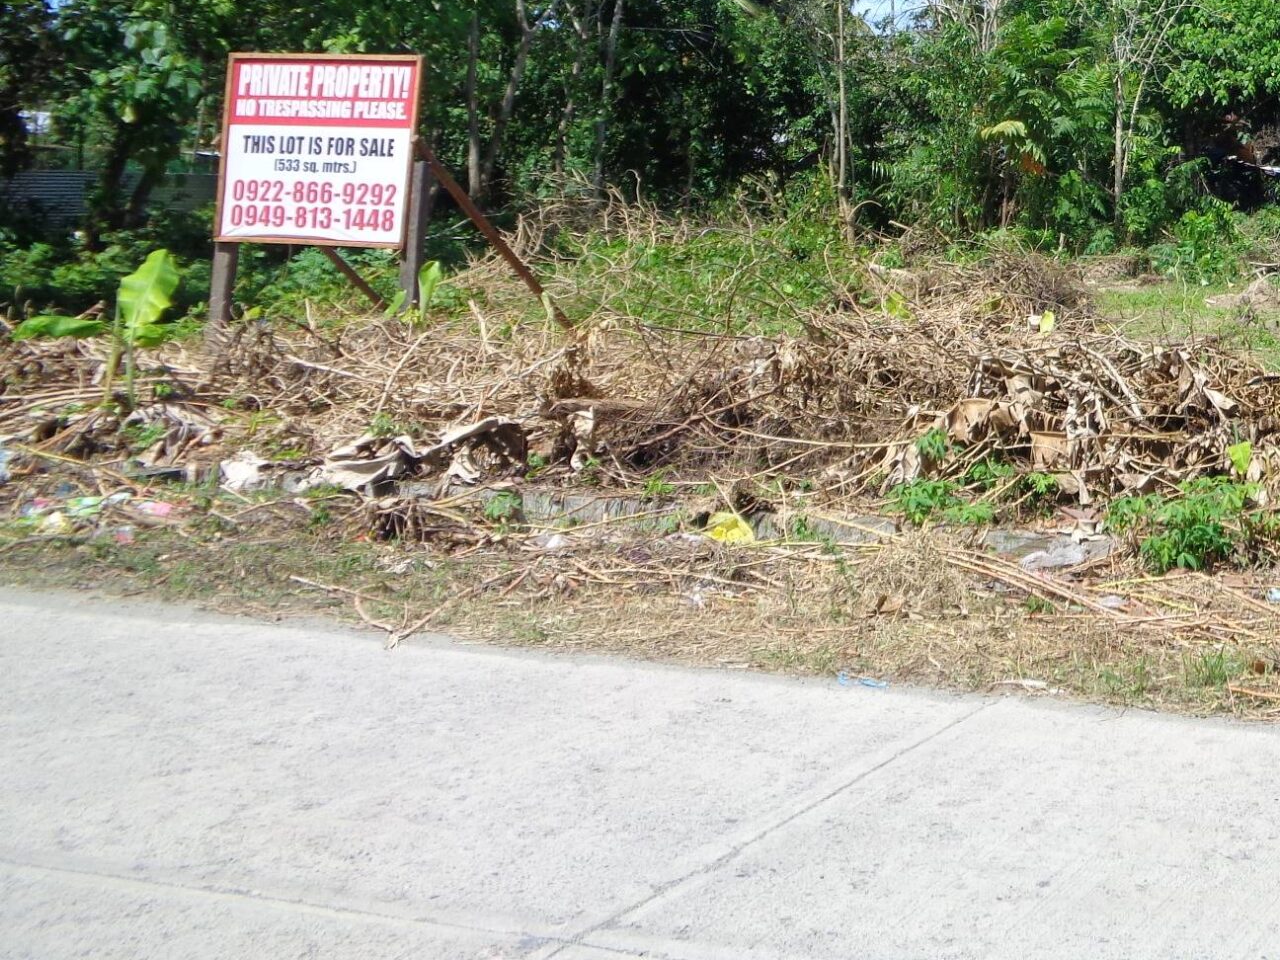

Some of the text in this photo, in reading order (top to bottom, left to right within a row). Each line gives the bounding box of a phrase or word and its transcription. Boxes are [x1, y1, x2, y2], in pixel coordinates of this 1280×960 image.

[238, 64, 411, 98] PRIVATE PROPERTY!
[235, 99, 407, 119] NO TRESPASSING PLEASE.
[243, 135, 395, 157] THIS LOT IS FOR SALE
[302, 161, 319, 174] sq.
[233, 180, 397, 206] 0922-866-9292
[230, 205, 395, 232] 0949-813-1448
